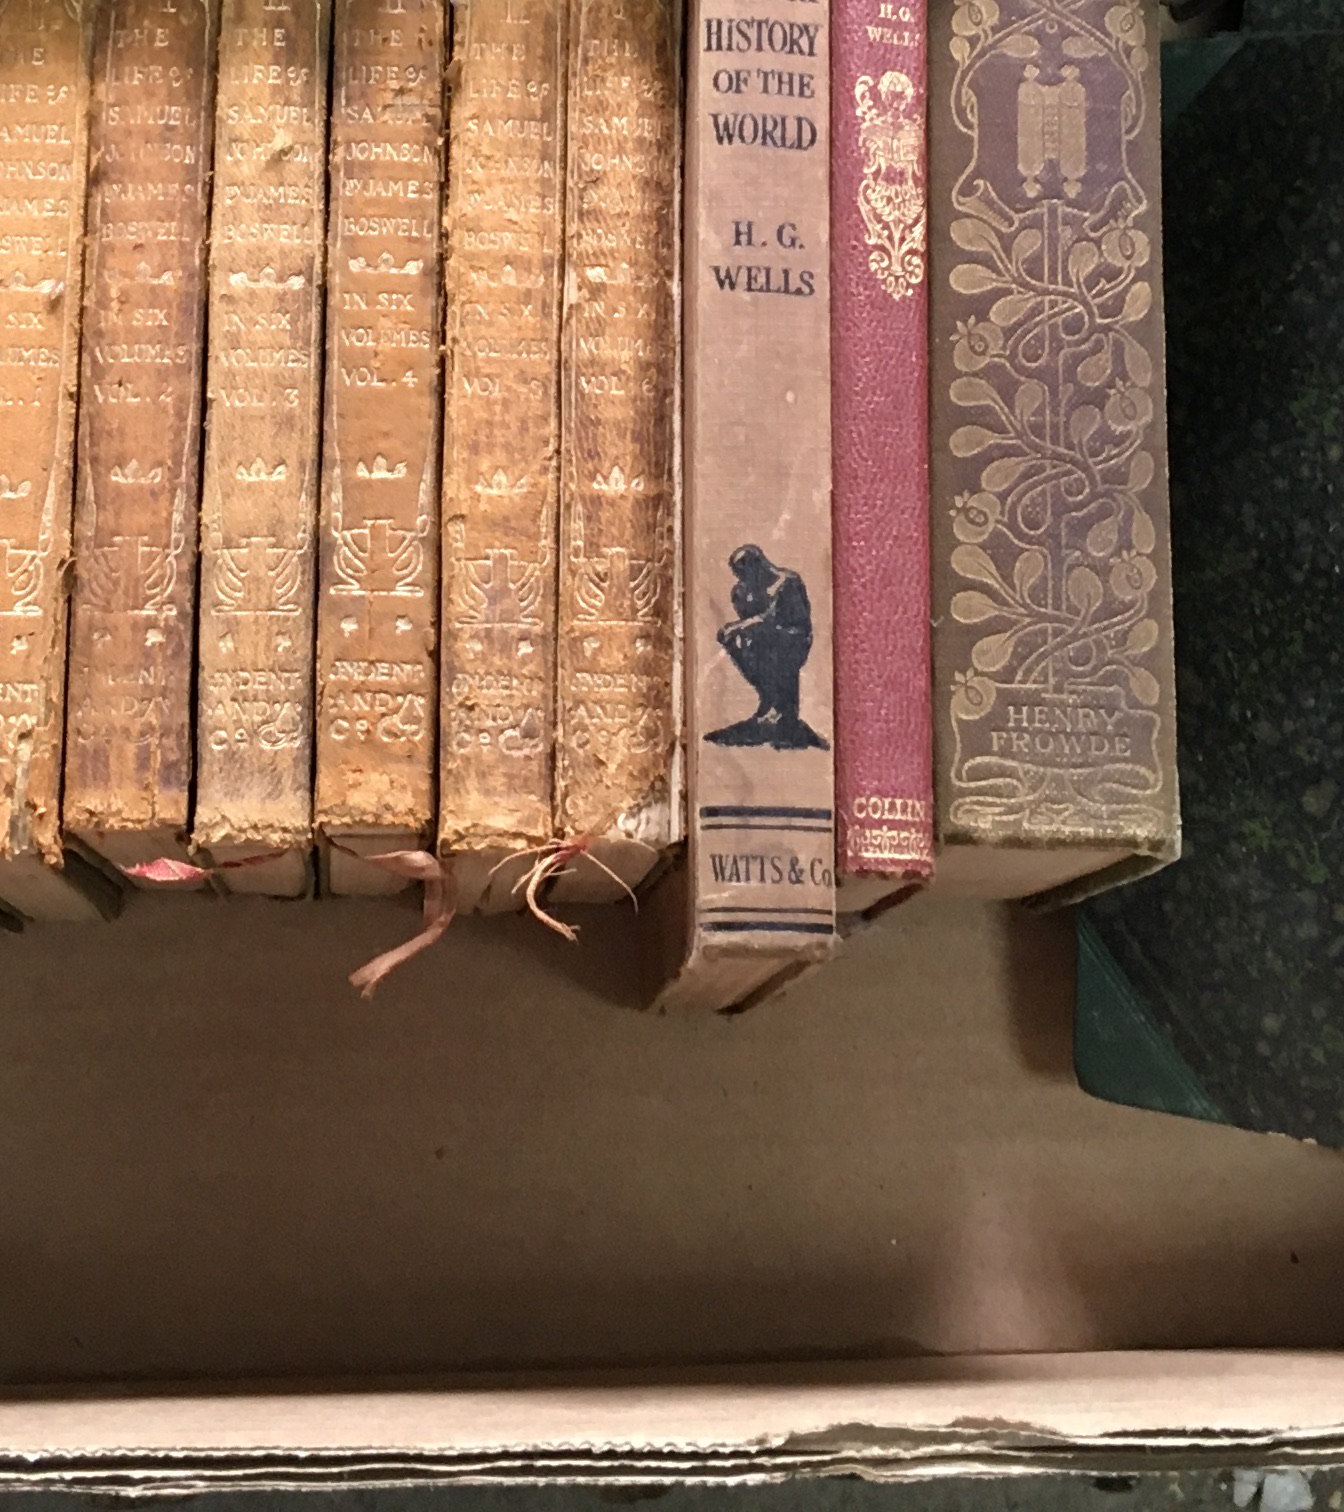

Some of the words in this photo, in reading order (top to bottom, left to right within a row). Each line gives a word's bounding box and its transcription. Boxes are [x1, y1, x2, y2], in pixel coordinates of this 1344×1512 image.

[703, 18, 819, 57] HISTORY
[348, 65, 400, 86] LIFE
[712, 68, 751, 94] OF
[756, 68, 816, 100] THE
[711, 112, 818, 152] WORLD
[345, 141, 434, 165] JOHNSON
[363, 179, 434, 199] JAMES
[343, 217, 433, 239] BOSWELL
[710, 265, 816, 297] WELLS
[342, 292, 368, 311] IN
[375, 292, 416, 312] SIX
[340, 327, 432, 349] VOLUMES
[402, 367, 419, 388] 4
[1007, 704, 1124, 731] HENRY
[990, 730, 1132, 757] FROWDE
[709, 852, 784, 885] WATTS
[787, 854, 805, 886] &
